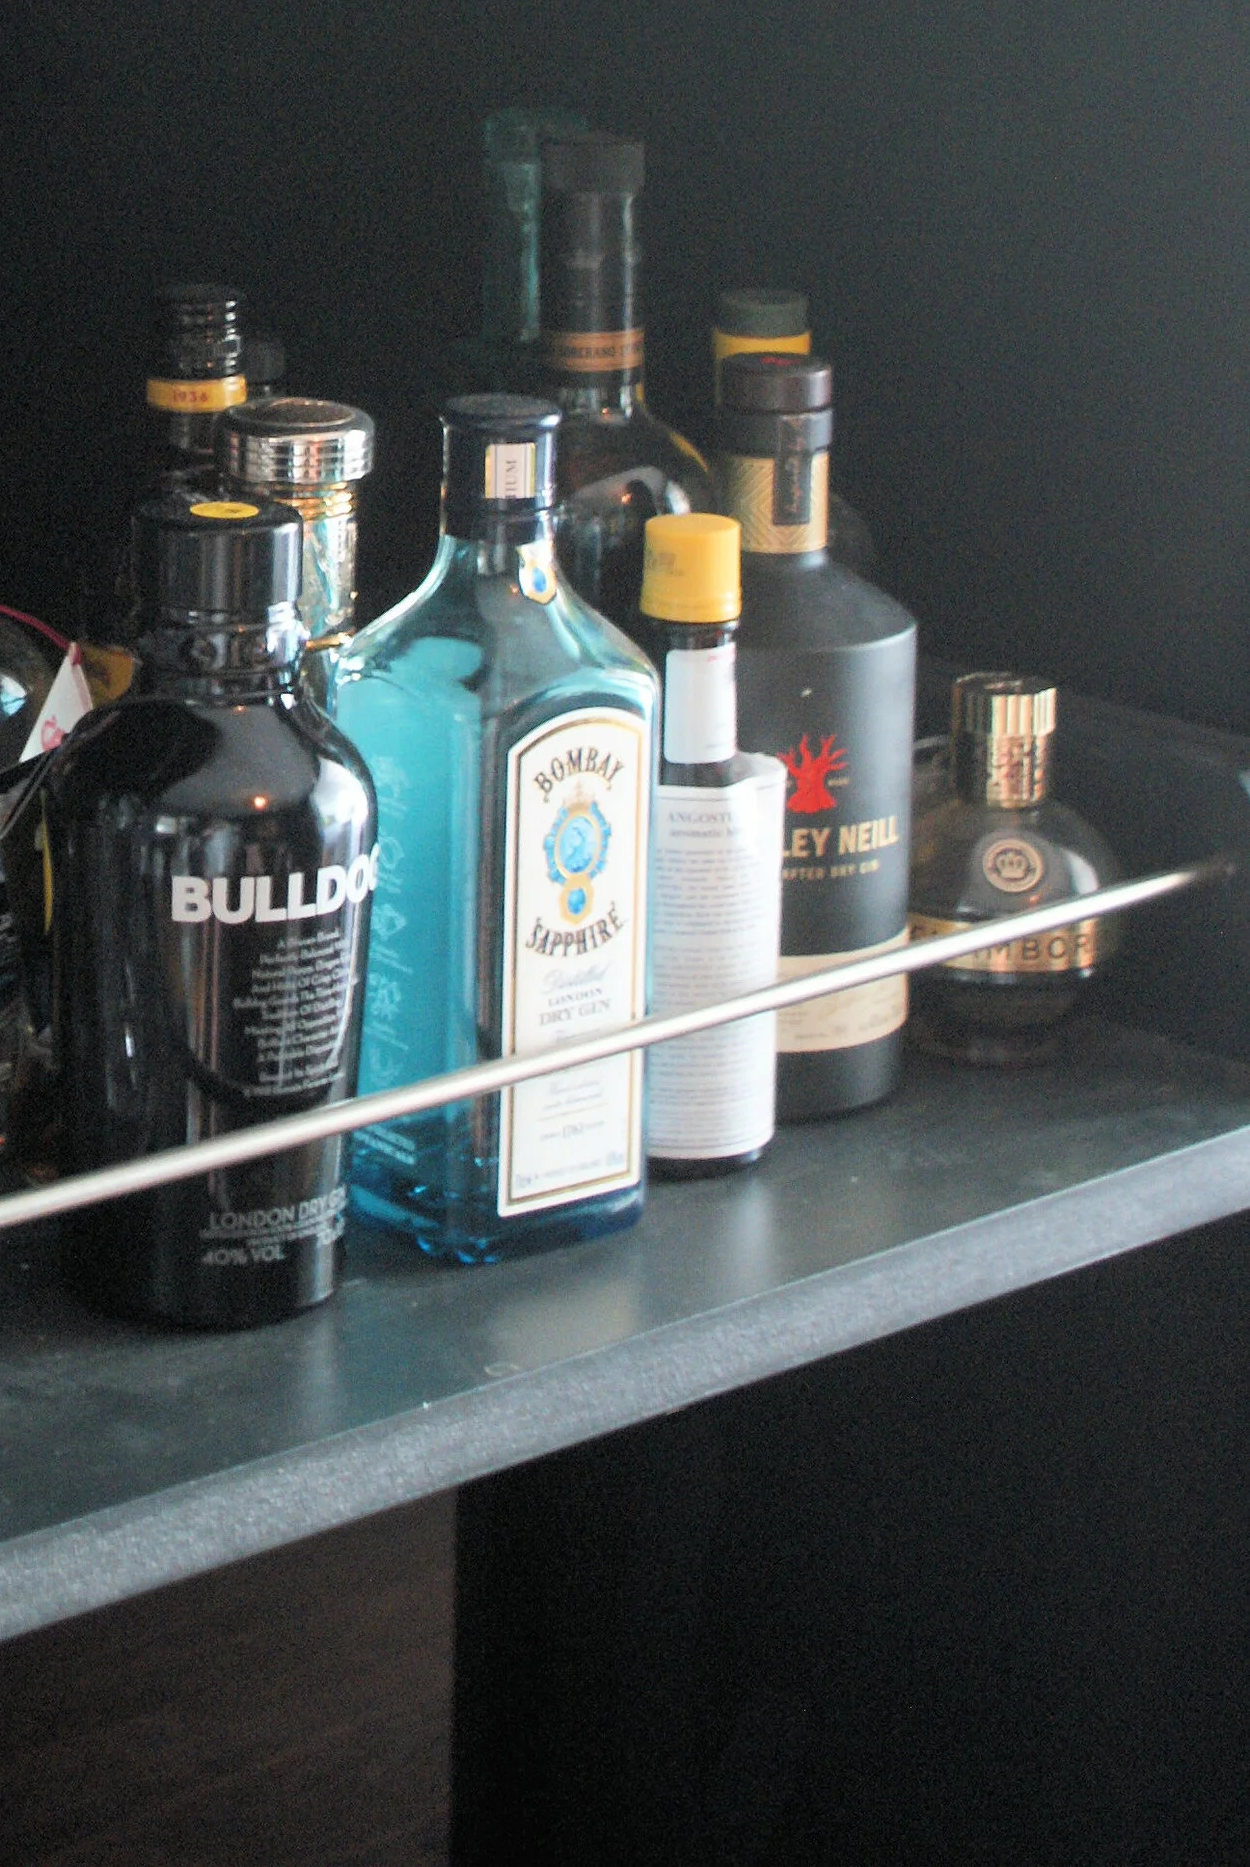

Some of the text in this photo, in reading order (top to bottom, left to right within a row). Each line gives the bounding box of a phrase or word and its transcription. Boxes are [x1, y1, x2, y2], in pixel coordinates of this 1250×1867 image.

[533, 746, 627, 803] BOMBAY
[838, 815, 901, 857] NEILL
[525, 900, 627, 957] SAPPHIRE
[539, 998, 612, 1026] DRY GIN
[548, 987, 603, 1007] LONDON
[209, 1205, 296, 1230] LONDON
